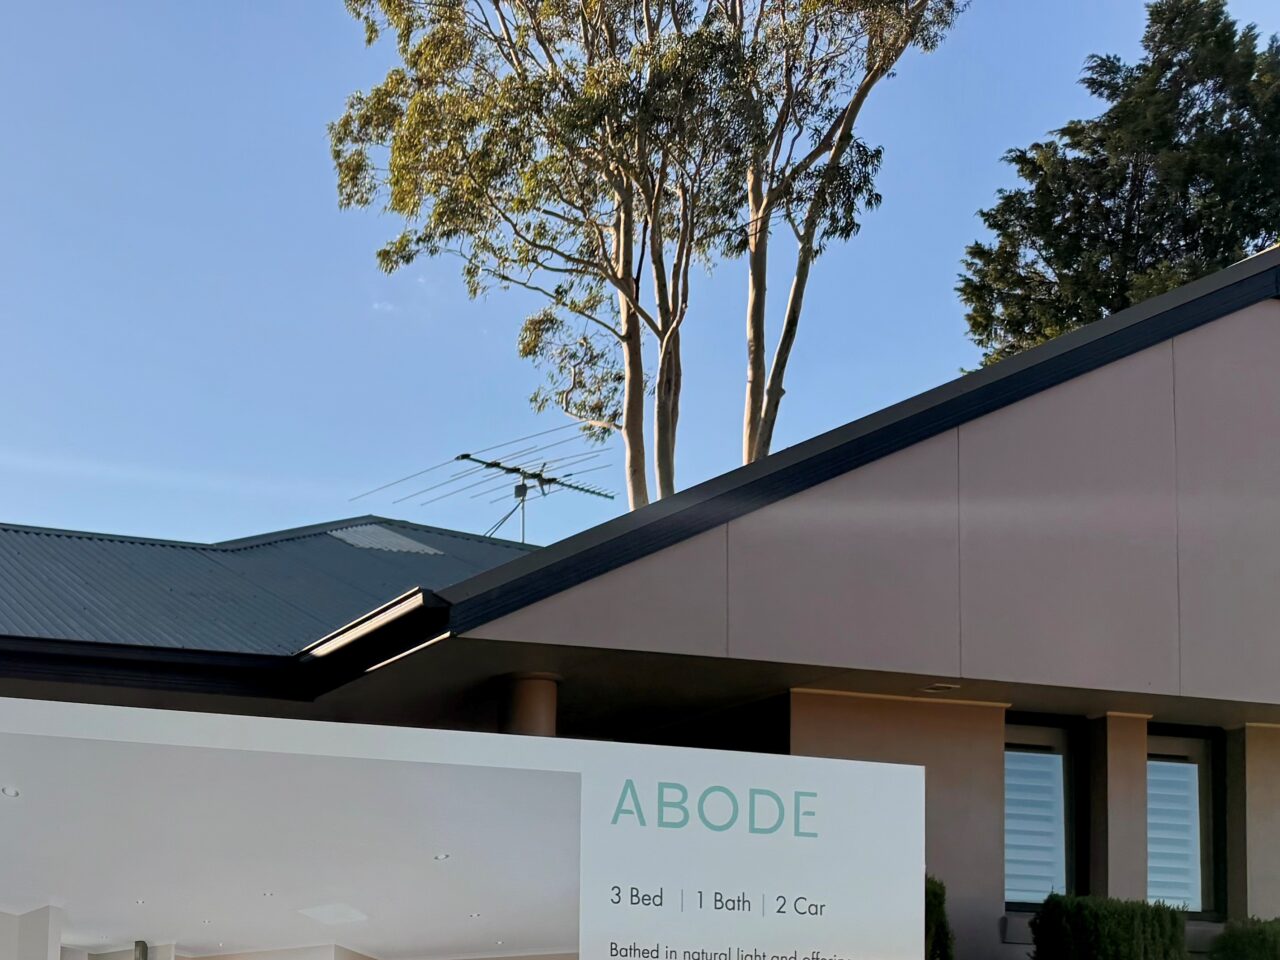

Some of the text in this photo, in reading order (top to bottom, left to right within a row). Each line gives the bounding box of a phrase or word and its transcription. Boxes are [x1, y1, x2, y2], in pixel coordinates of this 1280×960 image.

[610, 778, 819, 839] ABODE
[611, 886, 826, 916] 3 Bed 1 Bath 2 Car
[610, 942, 659, 959] Bathed
[665, 946, 677, 960] in
